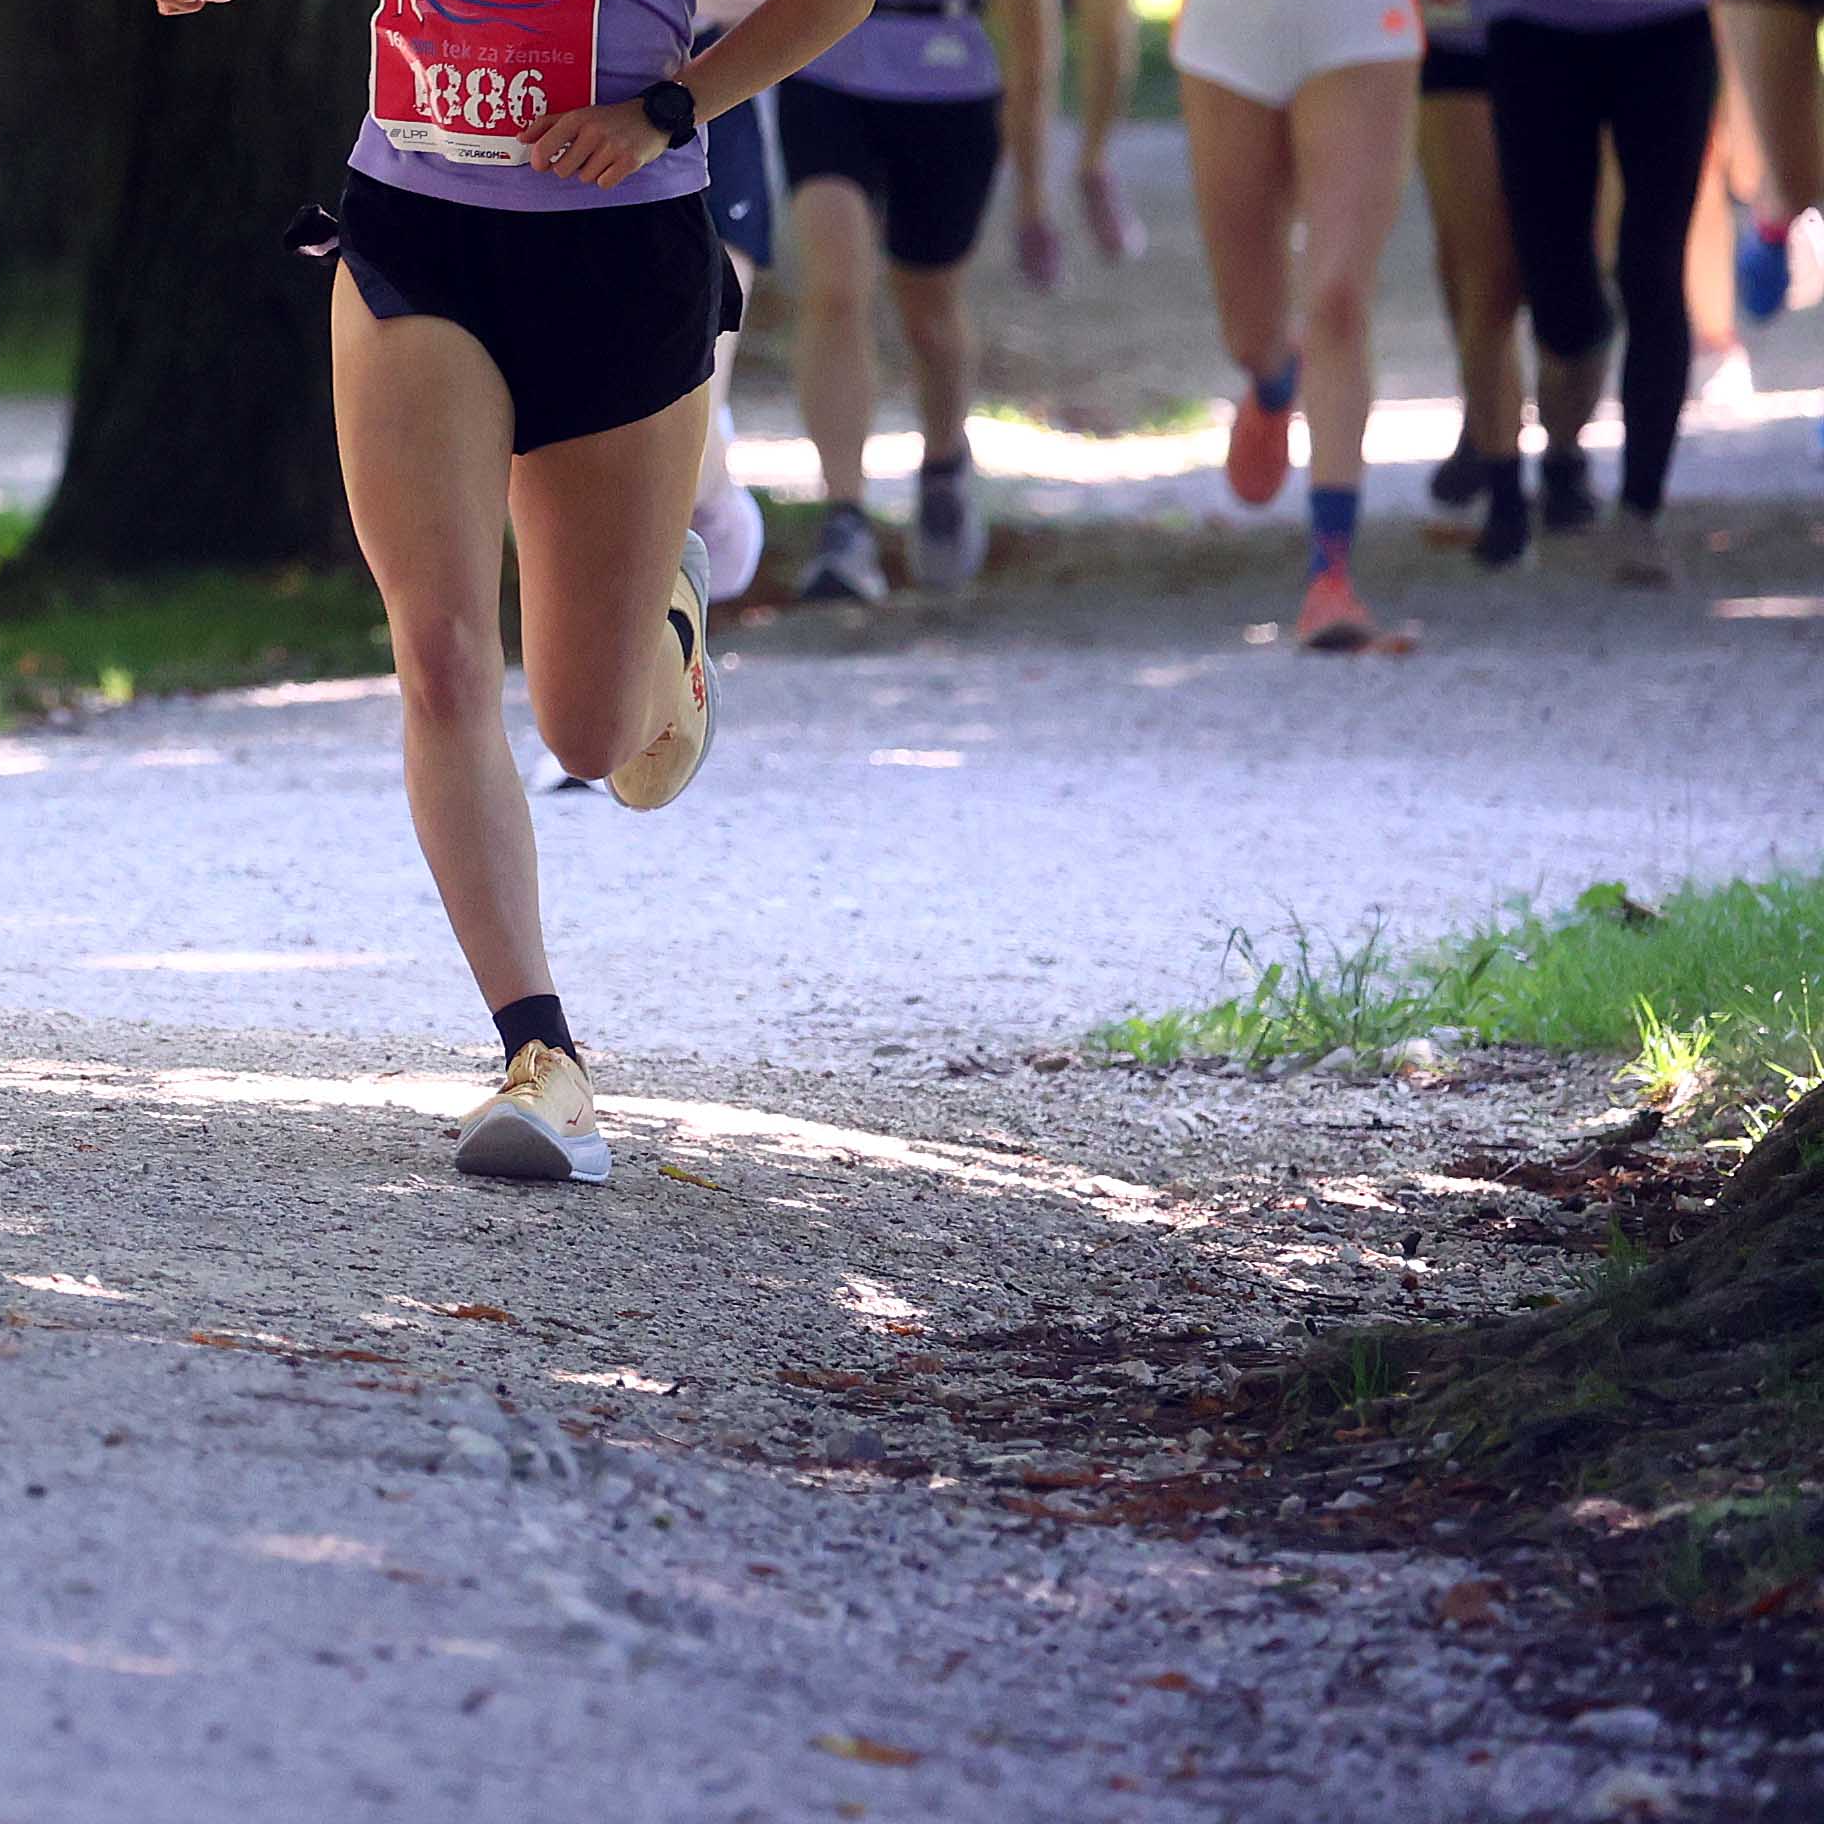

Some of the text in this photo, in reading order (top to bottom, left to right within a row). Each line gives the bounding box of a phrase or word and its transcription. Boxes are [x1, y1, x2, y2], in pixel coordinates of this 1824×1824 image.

[443, 40, 471, 59] tek
[478, 47, 498, 61] za
[505, 44, 576, 65] ženske
[402, 128, 429, 140] LPP
